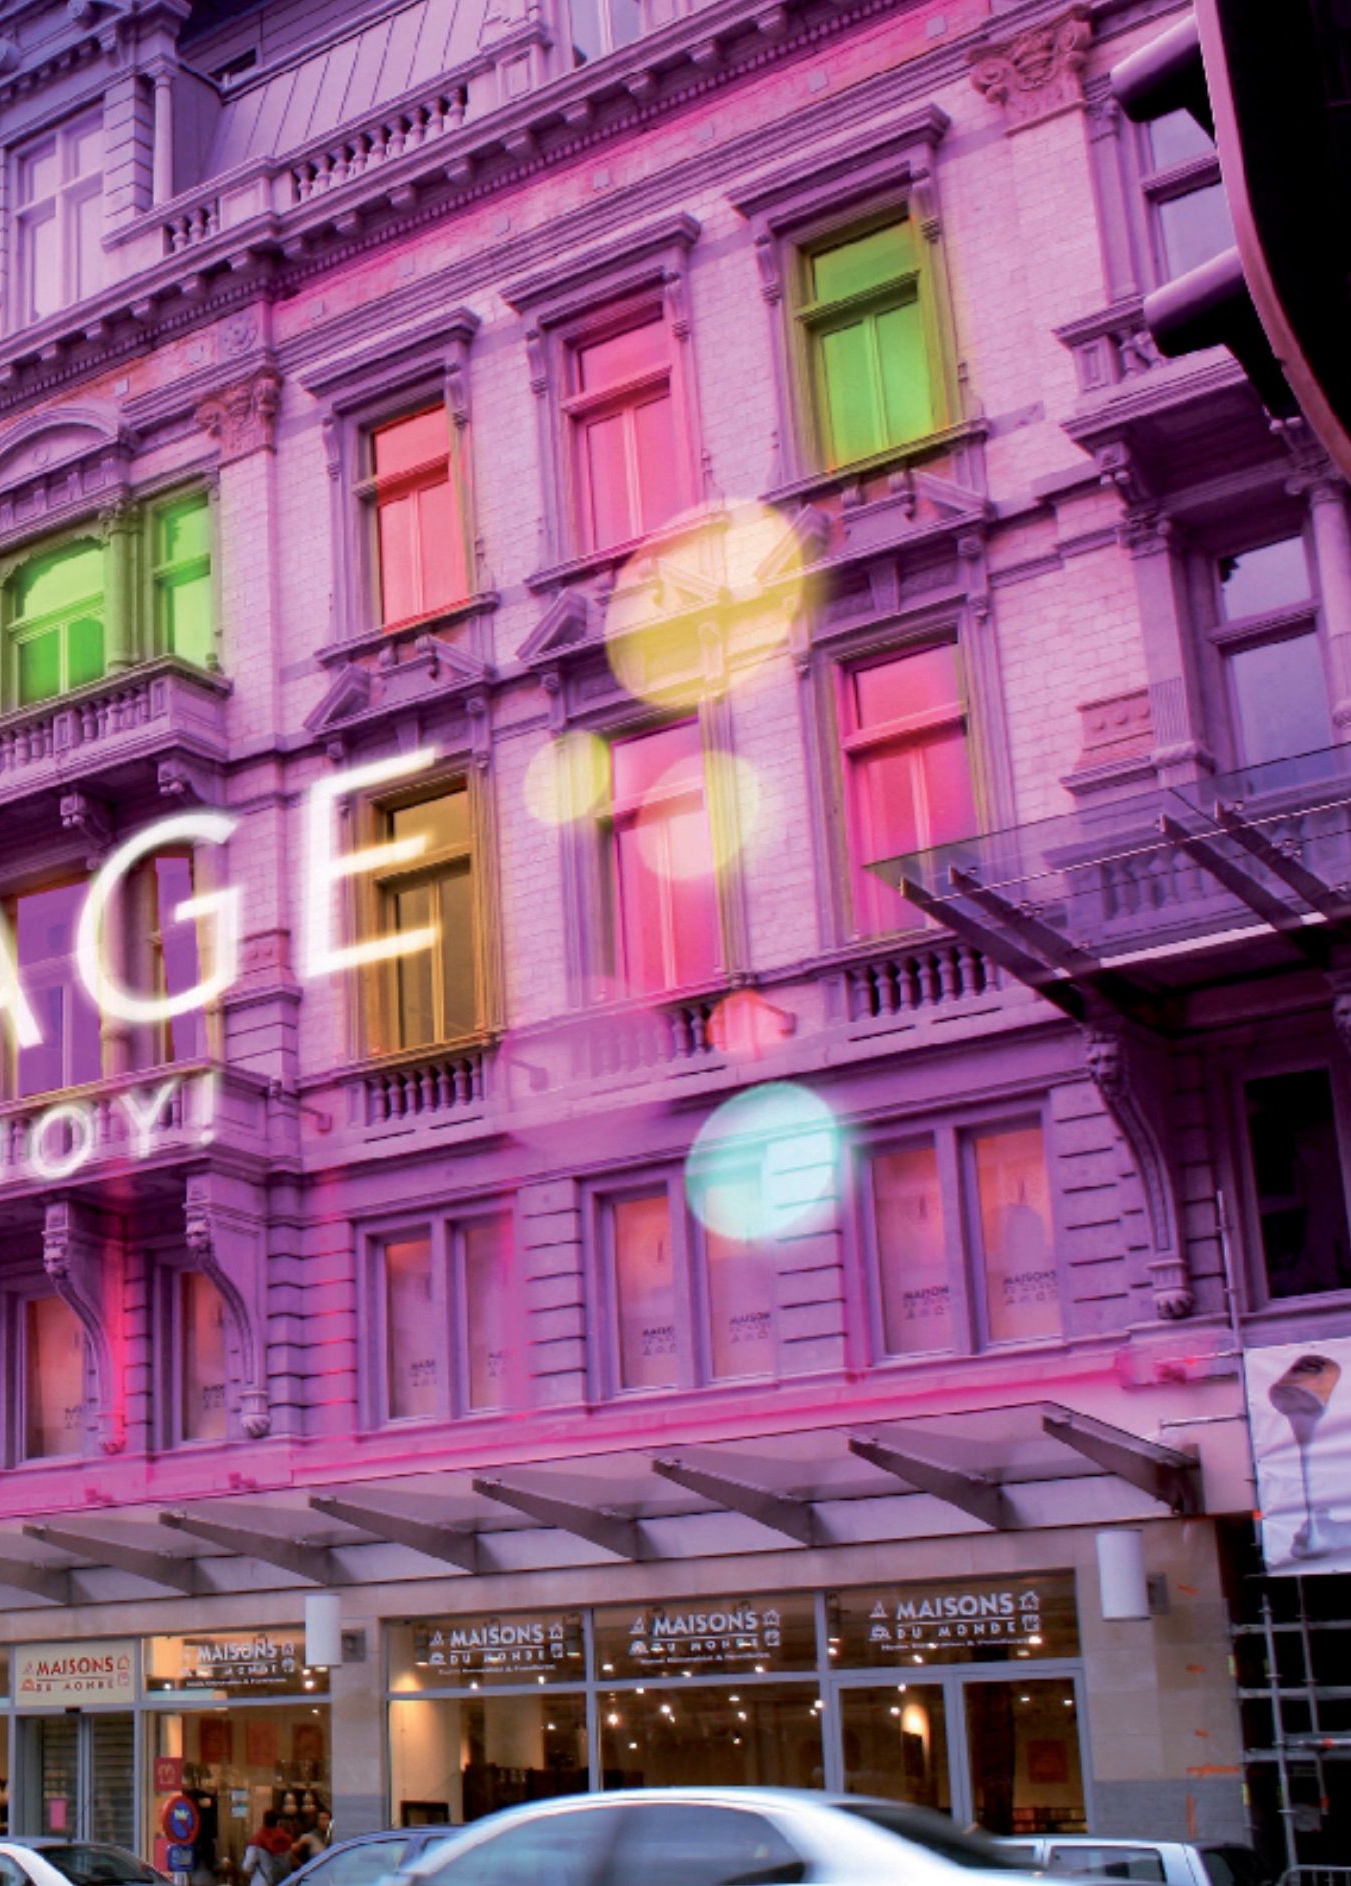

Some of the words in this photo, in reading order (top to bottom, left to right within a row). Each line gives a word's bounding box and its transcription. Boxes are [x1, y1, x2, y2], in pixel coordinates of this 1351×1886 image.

[897, 1592, 1016, 1620] MAISONS
[450, 1623, 545, 1648] MAISONS
[653, 1610, 758, 1637] MAISONS
[897, 1627, 922, 1640] DU
[938, 1620, 1017, 1638] MONDE
[198, 1641, 278, 1664] MAISONS
[37, 1655, 114, 1677] MAISONS
